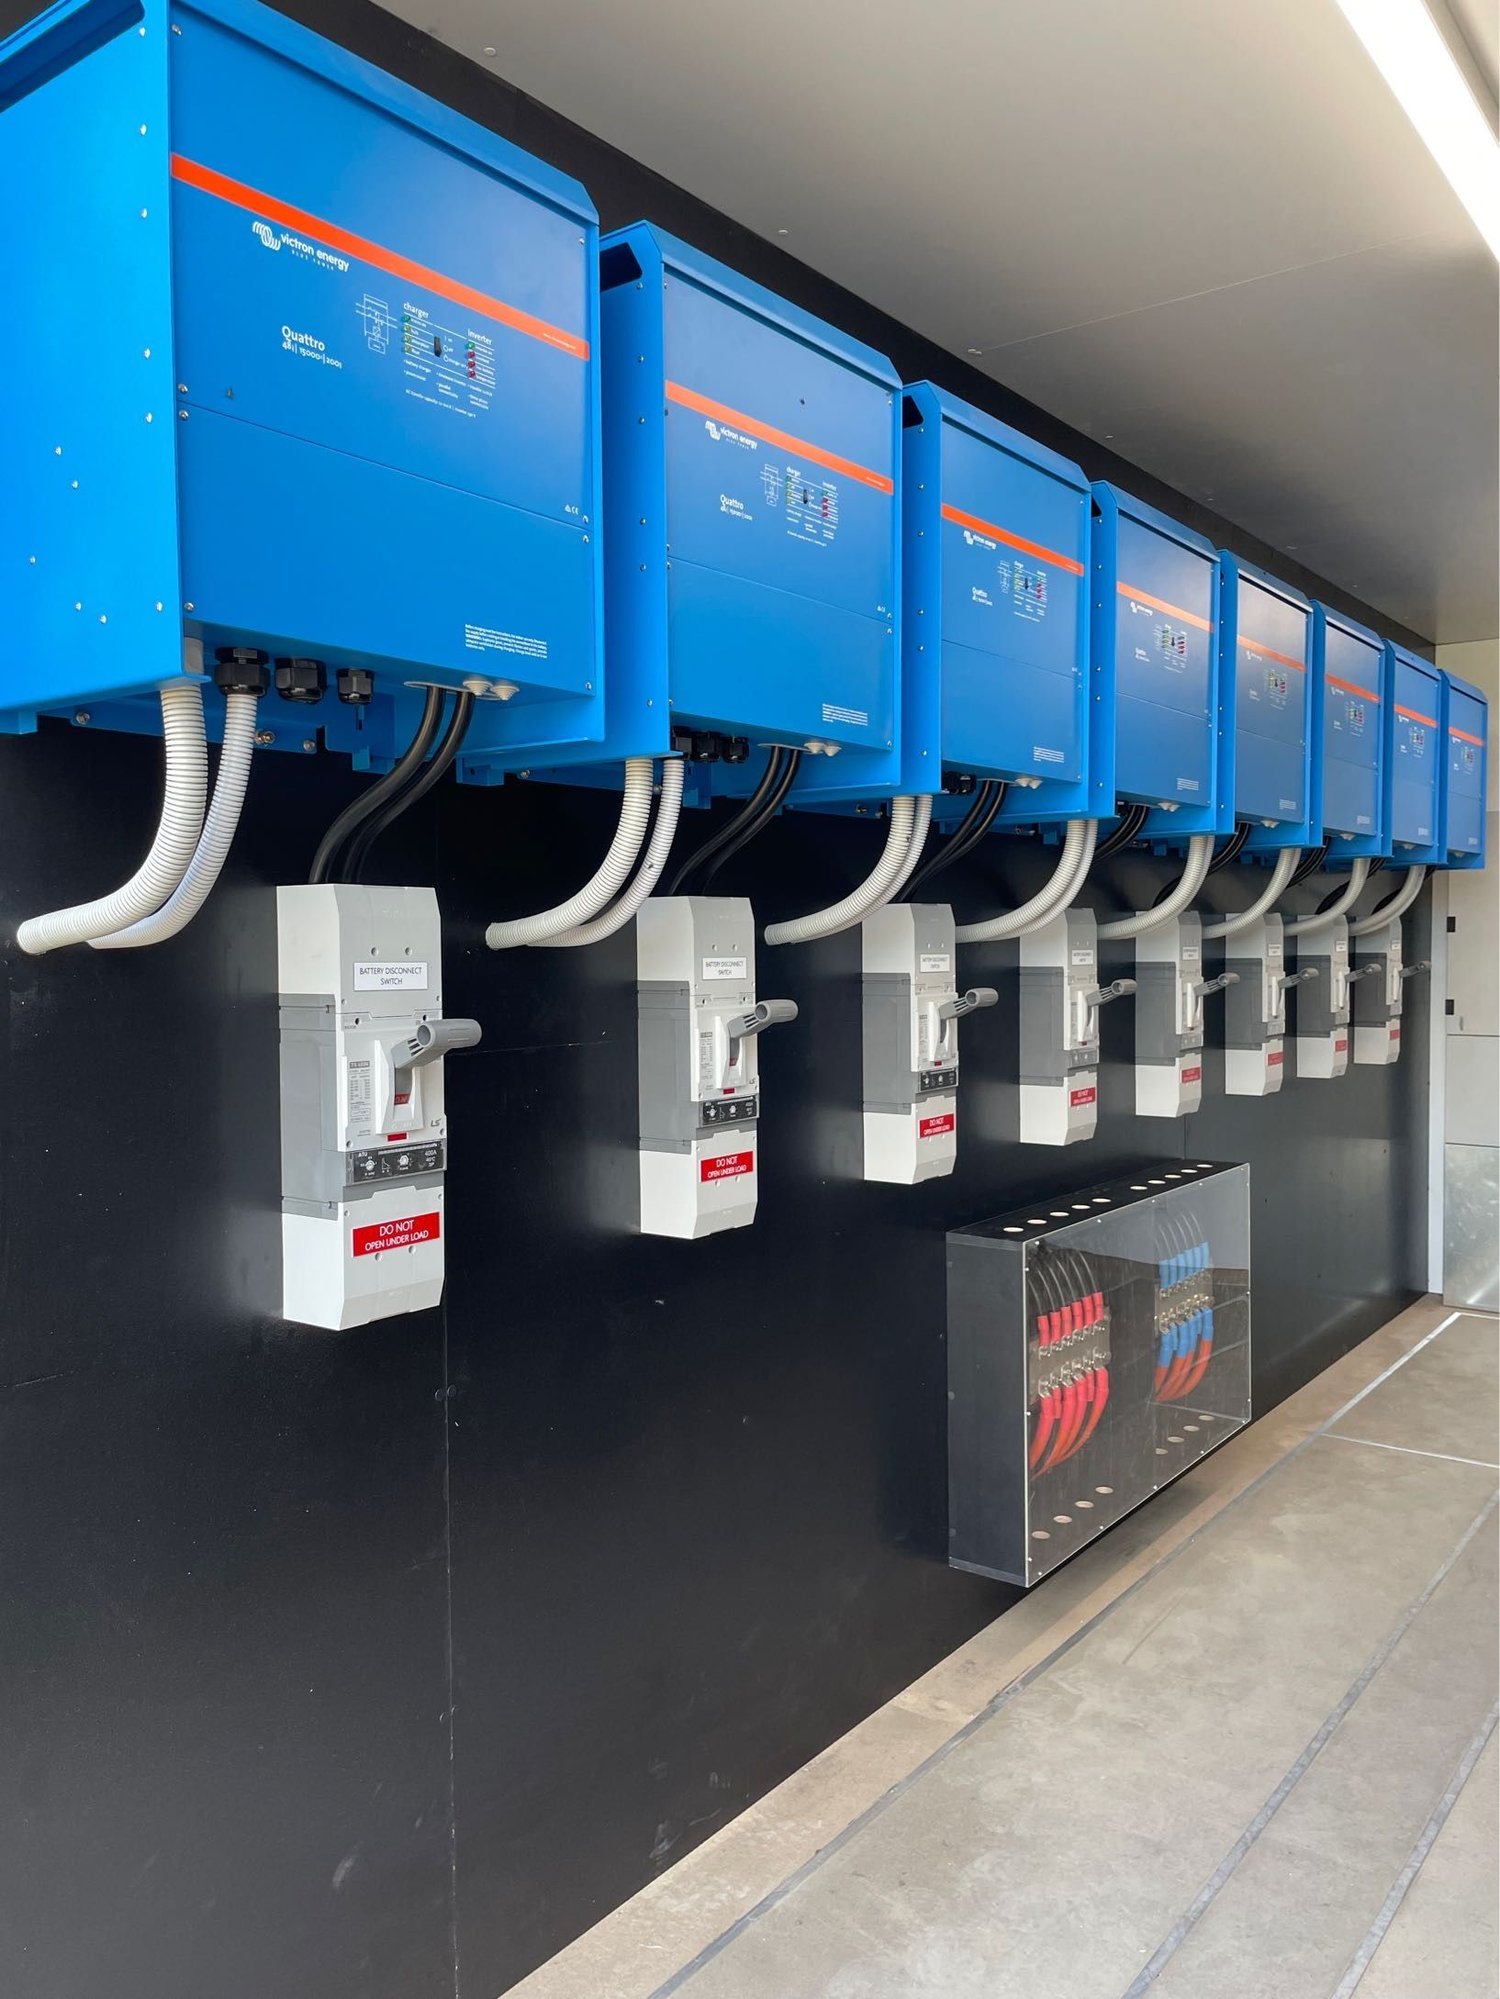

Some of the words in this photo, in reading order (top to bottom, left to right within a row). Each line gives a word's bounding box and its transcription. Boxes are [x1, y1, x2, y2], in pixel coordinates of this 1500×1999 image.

[281, 233, 315, 256] victron
[316, 249, 350, 272] energy
[403, 302, 430, 319] charger
[282, 325, 326, 352] Quattro
[467, 328, 492, 346] inverter
[359, 967, 384, 976] BATTERY
[385, 966, 423, 975] DISCONNECT
[380, 977, 403, 986] SWITCH
[716, 1159, 726, 1168] DO
[726, 1156, 738, 1165] NOT
[379, 1223, 394, 1237] DO
[395, 1219, 415, 1232] NOT
[364, 1240, 385, 1252] OPEN
[385, 1235, 410, 1248] UNDER
[410, 1230, 429, 1241] LOAD
